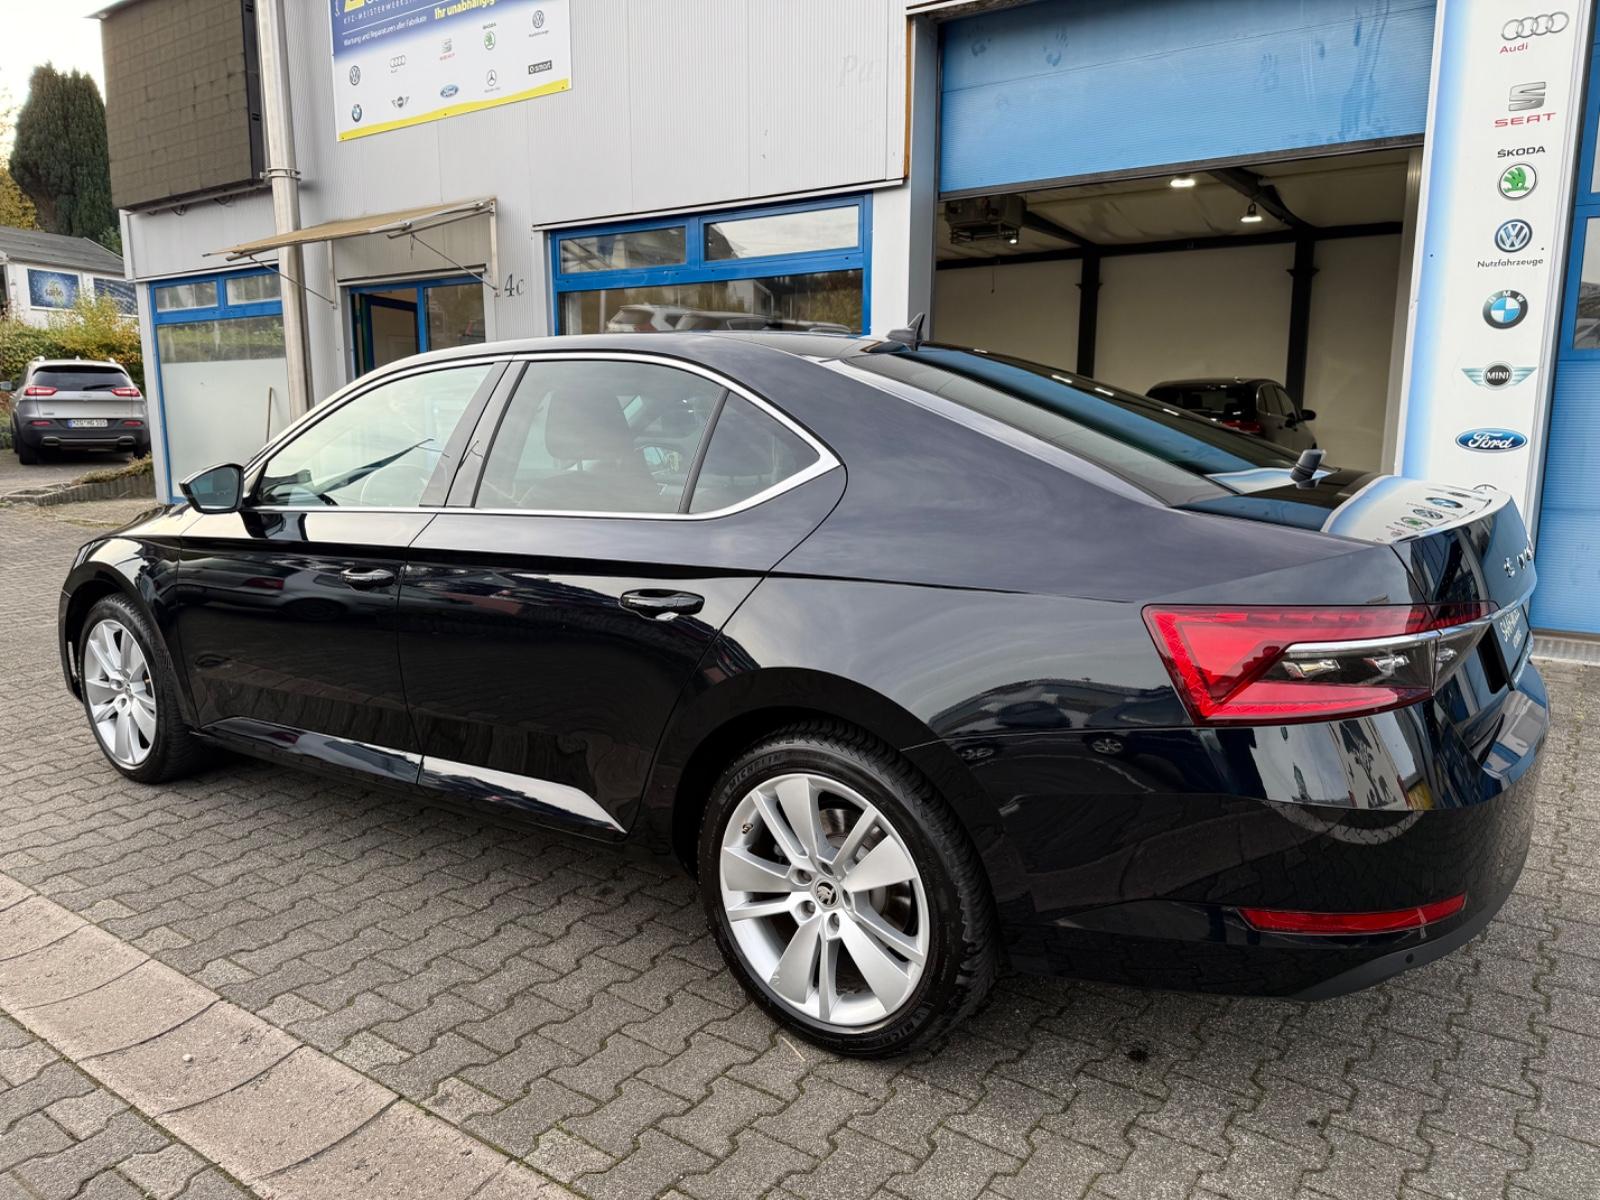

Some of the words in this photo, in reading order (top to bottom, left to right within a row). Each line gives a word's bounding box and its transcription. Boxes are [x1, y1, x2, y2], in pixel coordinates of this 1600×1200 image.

[434, 7, 447, 19] Ihr
[1499, 42, 1528, 54] Audi
[1494, 112, 1556, 128] SEAT
[1497, 146, 1546, 158] ŠKODA
[1477, 257, 1544, 268] Nutzfahrzeuge
[1488, 289, 1526, 304] BMW
[1486, 371, 1510, 380] MINI
[1467, 432, 1514, 449] Ford
